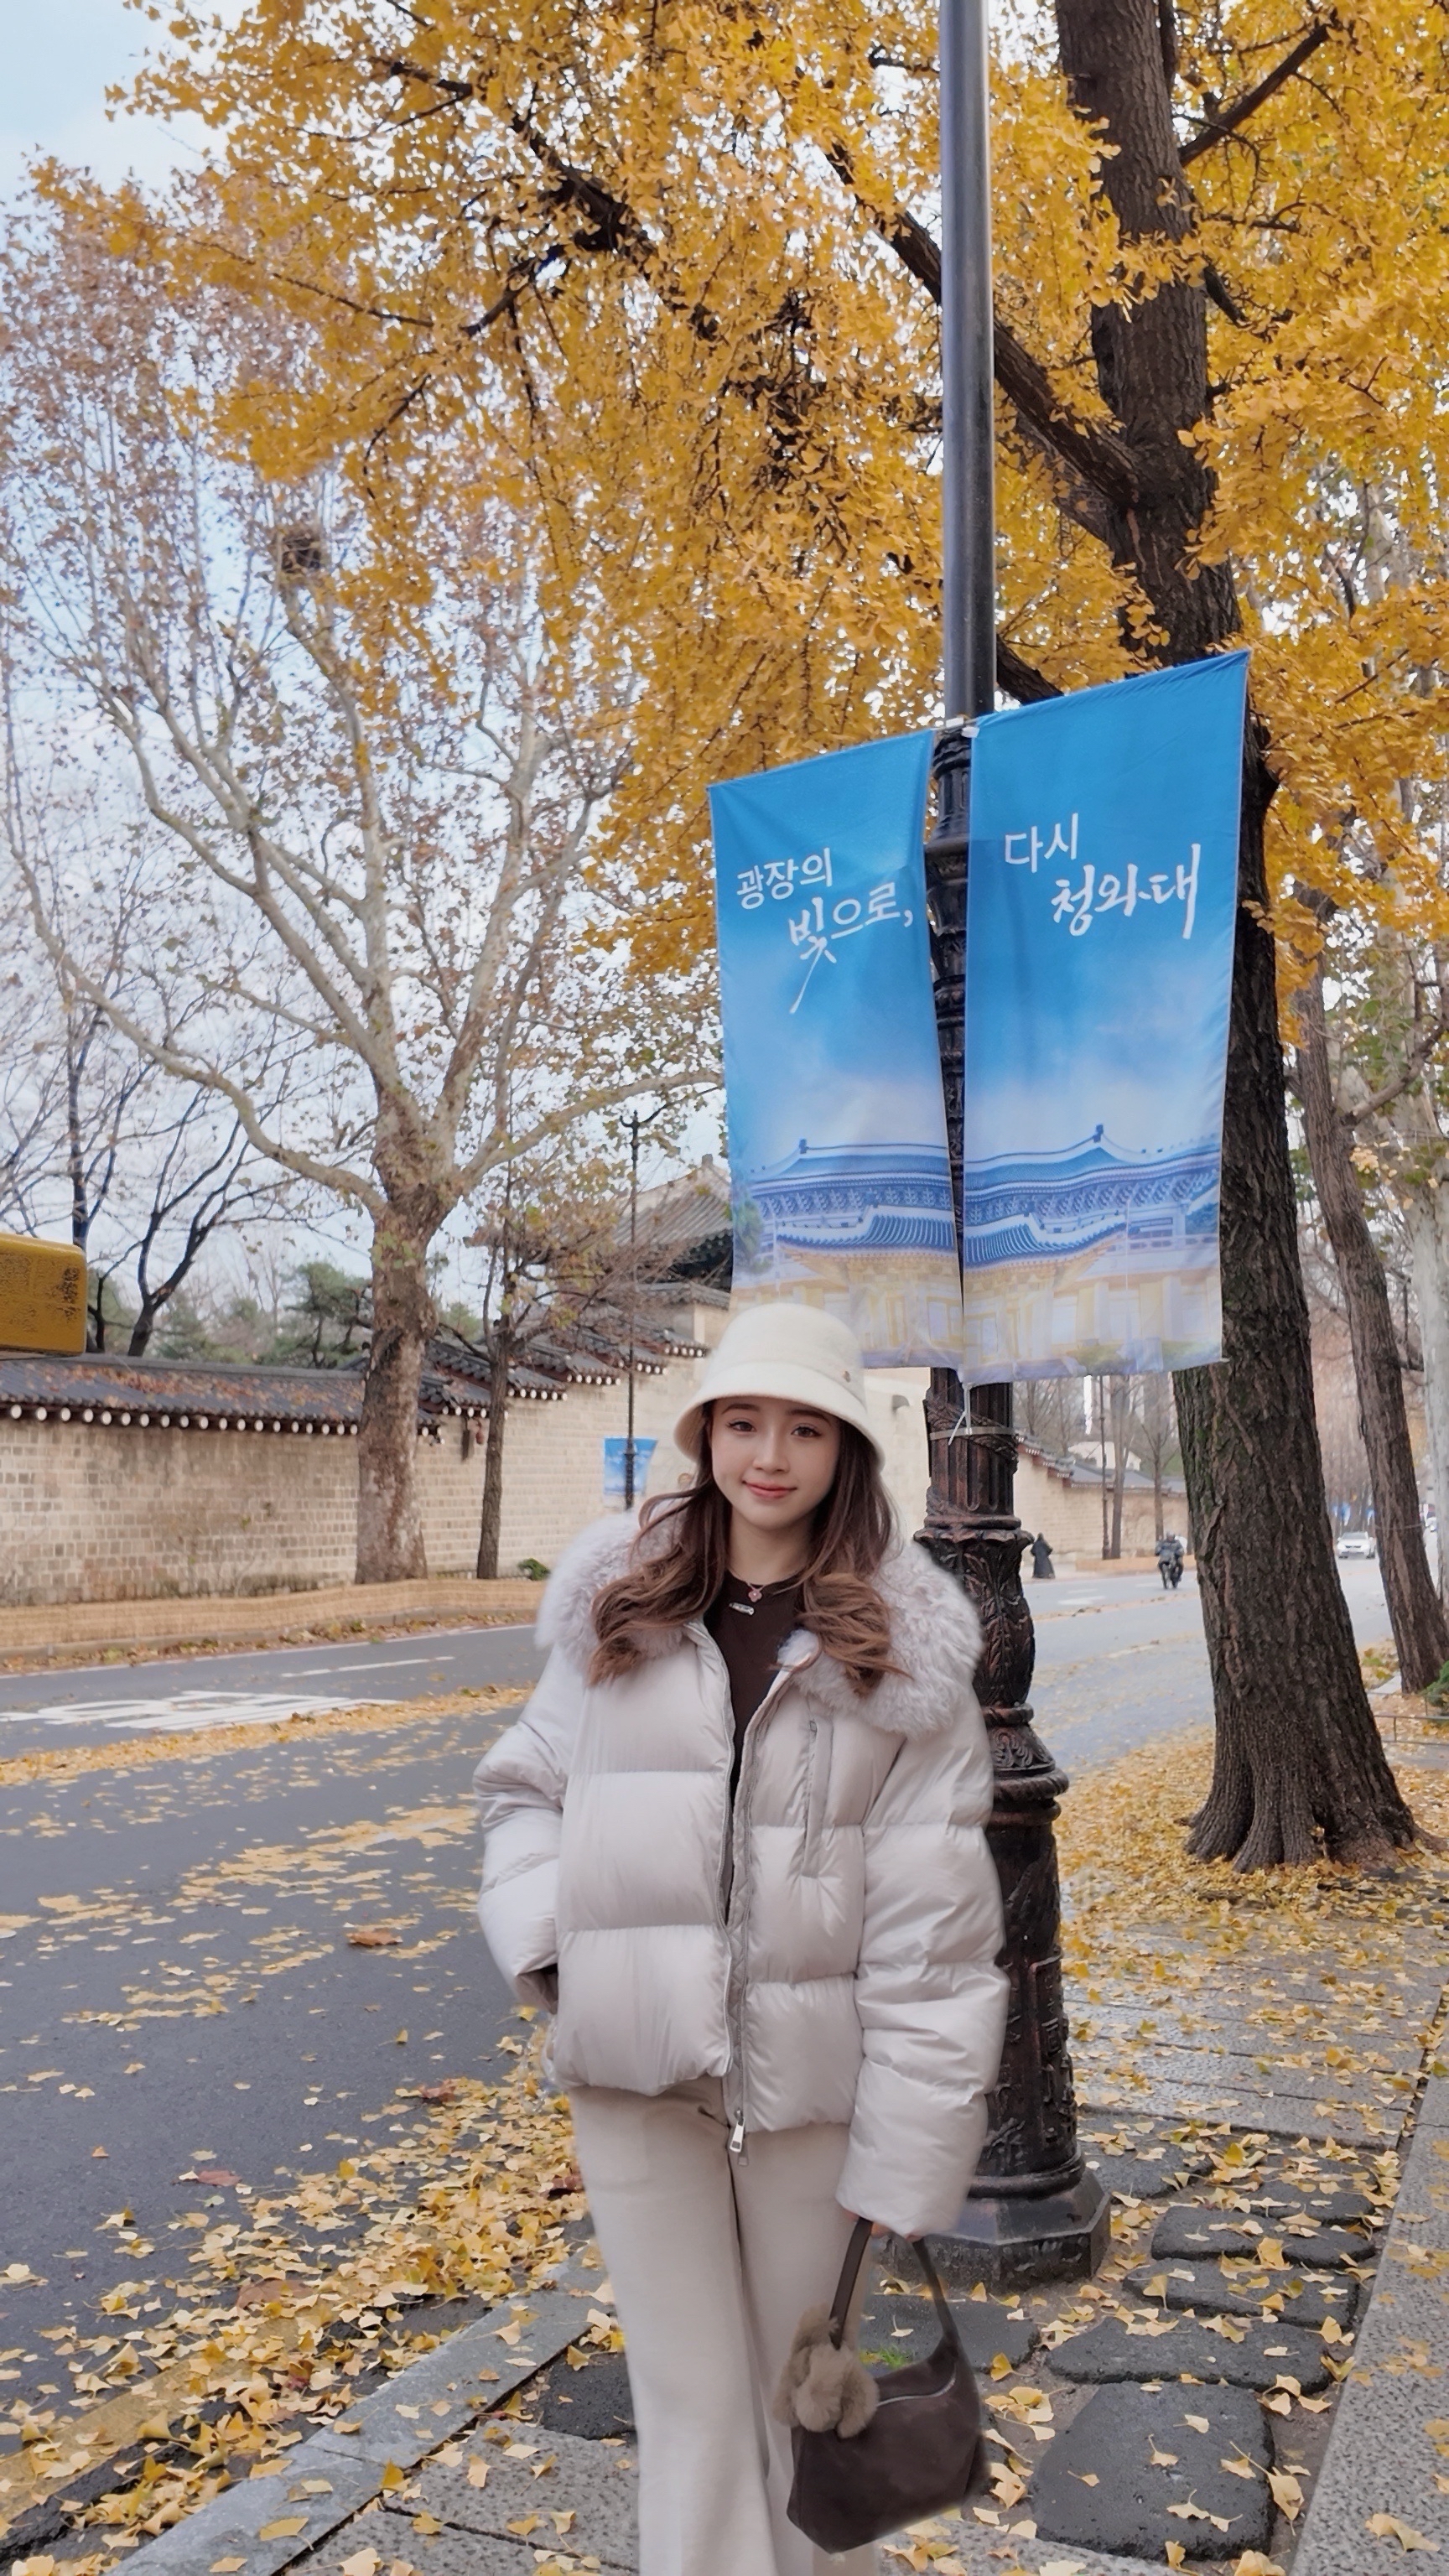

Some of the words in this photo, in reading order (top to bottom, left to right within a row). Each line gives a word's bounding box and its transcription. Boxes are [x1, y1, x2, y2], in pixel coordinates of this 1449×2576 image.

[736, 847, 833, 910] 광장의
[1005, 812, 1079, 874] 다시
[1051, 843, 1201, 939] 청와대
[788, 881, 914, 1014] 빛으로,
